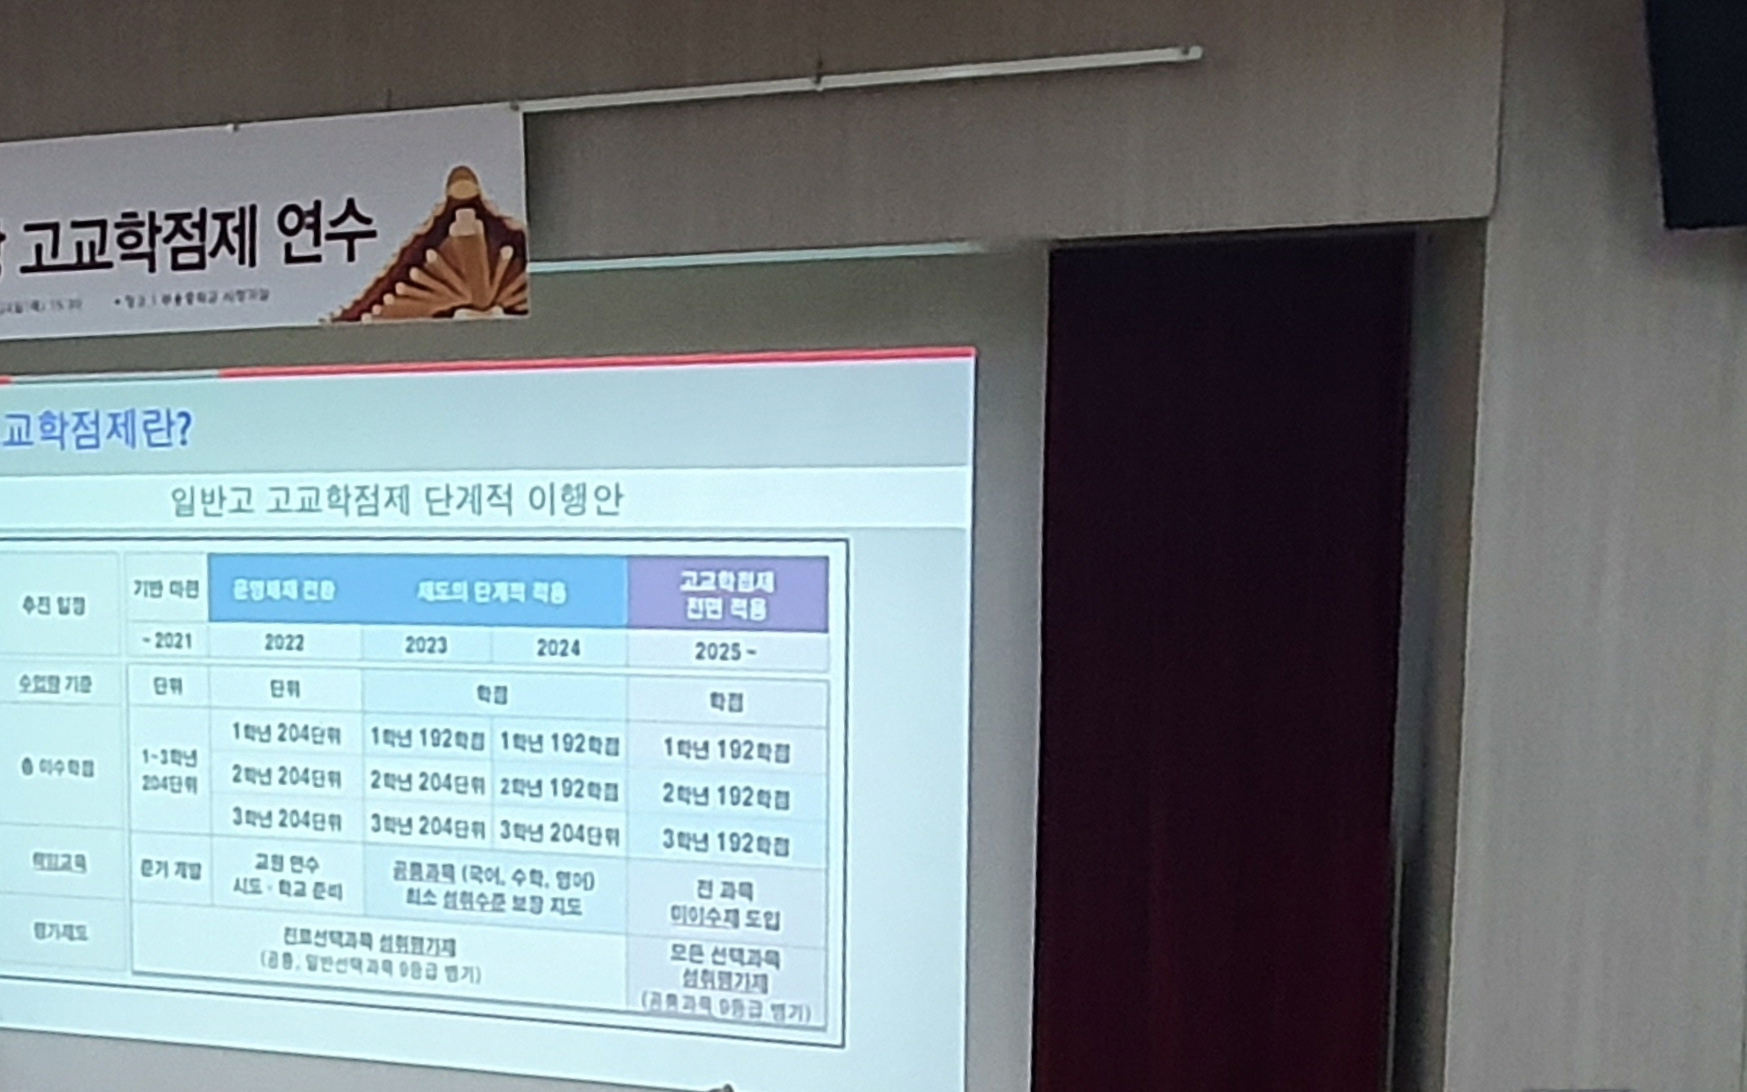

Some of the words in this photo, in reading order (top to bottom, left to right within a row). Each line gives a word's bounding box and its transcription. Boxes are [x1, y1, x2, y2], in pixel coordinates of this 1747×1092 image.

[19, 203, 258, 274] 고교학점제
[277, 197, 378, 265] 연수
[171, 484, 255, 518] 일반고
[265, 483, 411, 518] 고교학점제
[424, 482, 513, 518] 단계적
[527, 481, 625, 518] 이행안
[264, 633, 305, 652] 2022
[404, 636, 448, 655] 2023
[536, 638, 581, 658] 2024
[270, 679, 301, 698] 단위
[232, 721, 272, 743] 1학년
[277, 722, 342, 745] 204단위
[370, 726, 413, 748] 1학년
[500, 731, 544, 753] 1학년
[664, 736, 710, 760] 1학년
[232, 763, 272, 787] 2학년
[278, 765, 342, 789] 204단위
[370, 769, 413, 792] 2학년
[419, 771, 486, 795] 204단위
[500, 778, 543, 798] 2학년
[662, 782, 710, 806] 2학년
[232, 806, 272, 829] 3학년
[278, 808, 342, 832] 204단위
[370, 813, 413, 836] 3학년
[419, 814, 486, 840] 204단위
[500, 819, 544, 843] 3학년
[550, 821, 620, 847] 204단위
[662, 827, 710, 852] 3학년
